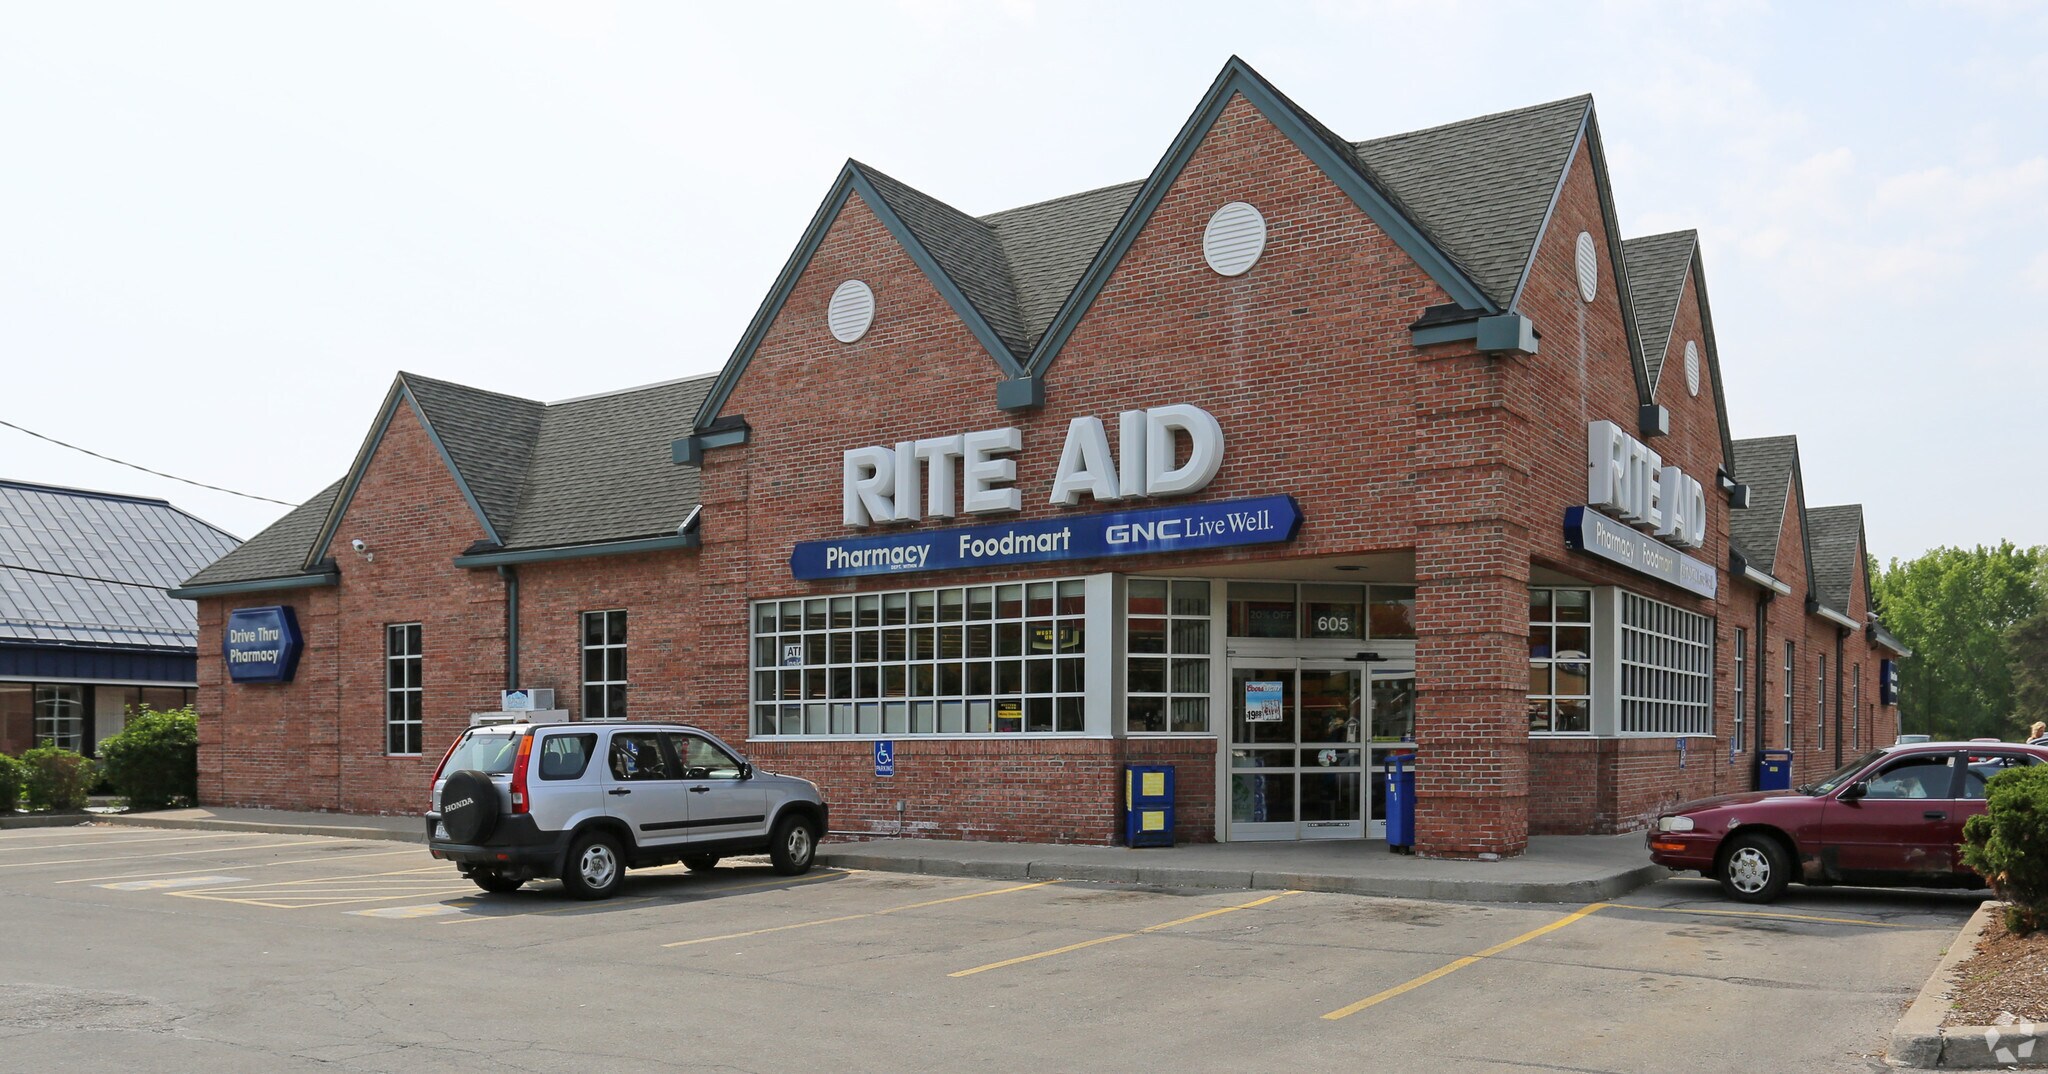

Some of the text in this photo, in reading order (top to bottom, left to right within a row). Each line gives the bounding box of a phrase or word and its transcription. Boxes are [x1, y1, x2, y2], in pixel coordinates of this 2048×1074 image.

[843, 404, 1225, 527] RITE AID
[1588, 420, 1707, 549] RITE AID
[826, 544, 930, 570] Pharmacy
[959, 527, 1071, 558] Foodmart
[1105, 519, 1181, 545] GNC
[1184, 516, 1225, 537] Live
[1596, 521, 1673, 572] Pharmacy Foodmart
[230, 627, 279, 643] Drive Thru
[1317, 616, 1349, 632] 605
[230, 649, 279, 664] Pharmacy
[445, 797, 474, 813] HONDA
